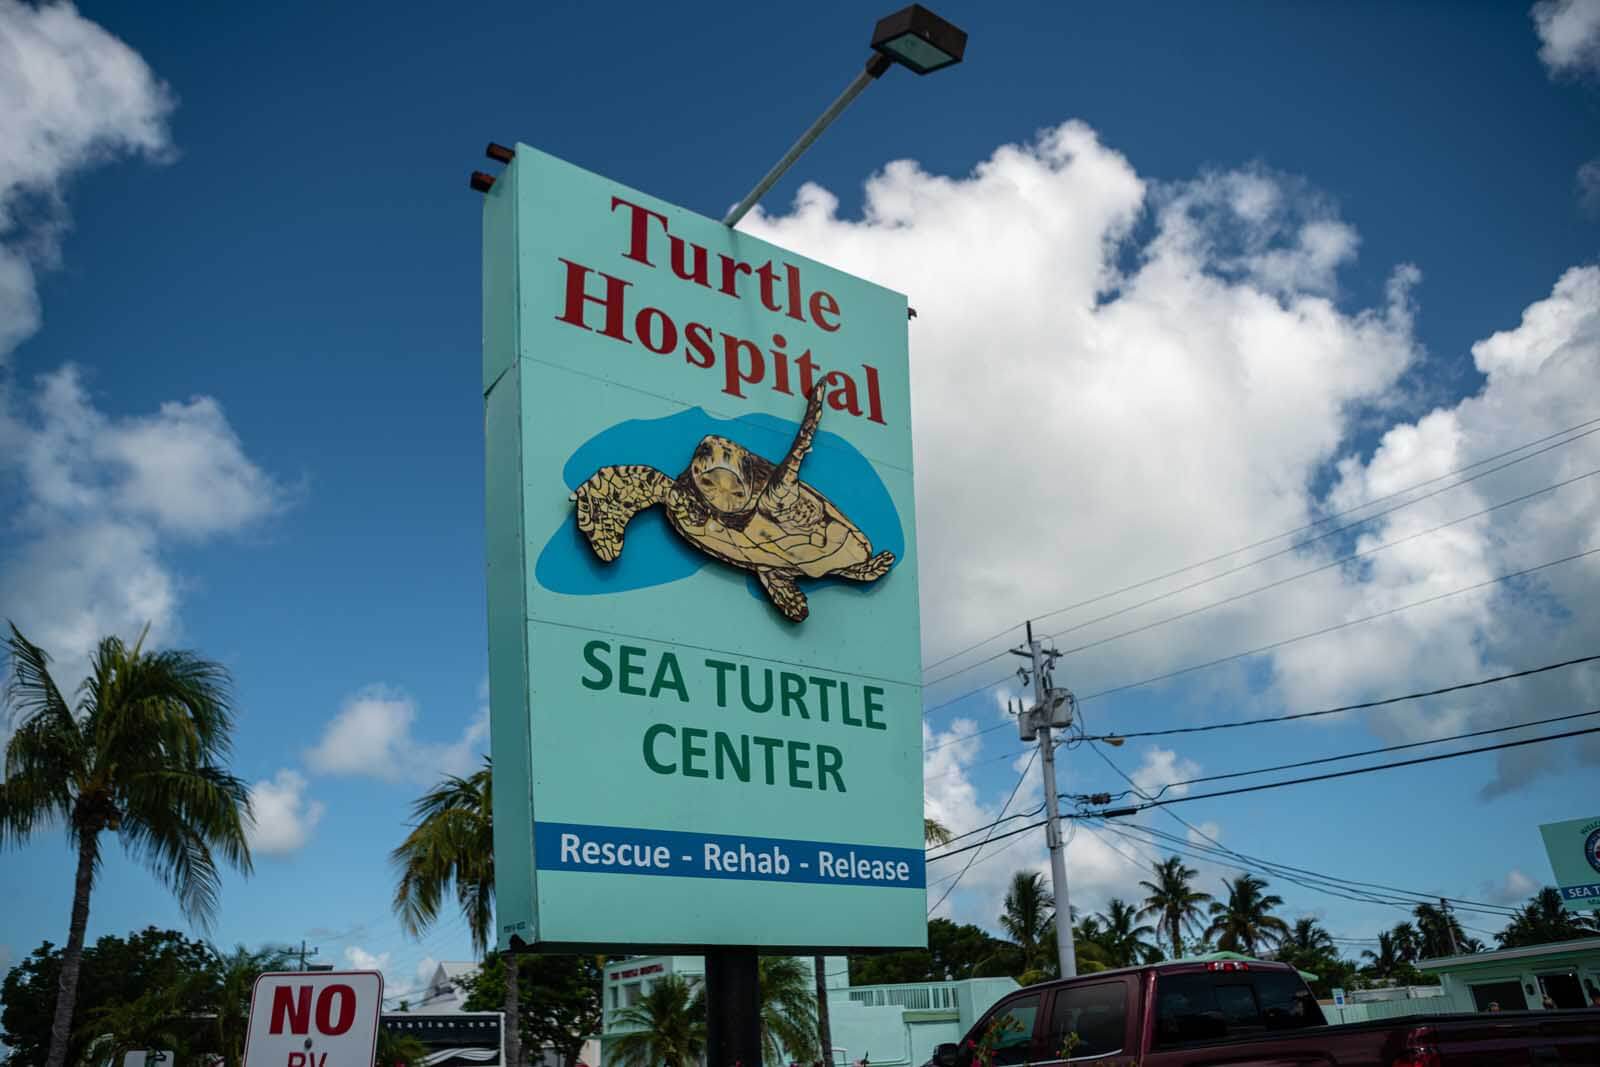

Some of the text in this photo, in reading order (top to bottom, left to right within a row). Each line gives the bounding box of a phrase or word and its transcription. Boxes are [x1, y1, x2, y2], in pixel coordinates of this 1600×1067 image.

[611, 197, 841, 332] Turtle
[555, 258, 887, 425] Hospital
[582, 640, 887, 731] SEA TURTLE
[642, 723, 847, 792] CENTER
[560, 833, 670, 868] Rescue
[704, 843, 790, 875] Rehab
[819, 850, 910, 881] Release
[1568, 887, 1592, 898] SEA
[269, 984, 357, 1036] NO
